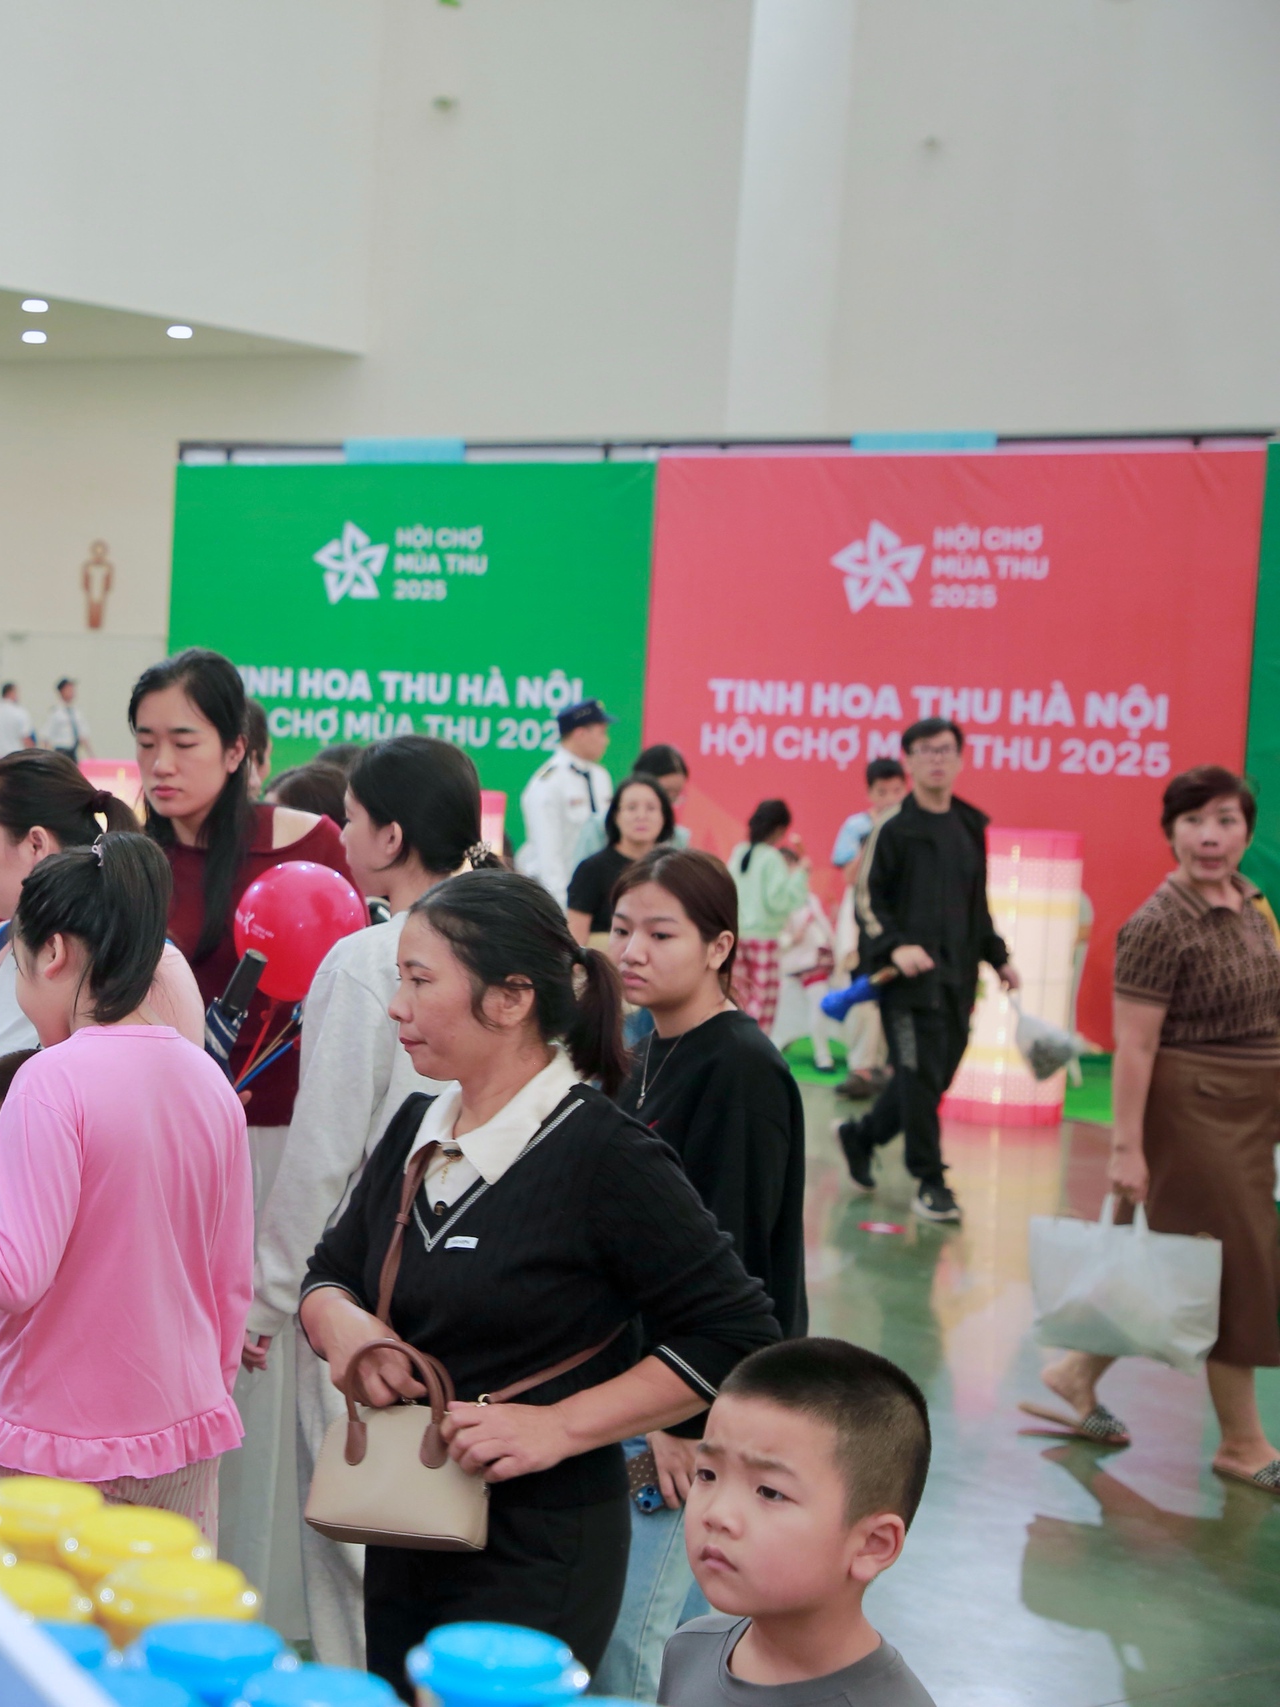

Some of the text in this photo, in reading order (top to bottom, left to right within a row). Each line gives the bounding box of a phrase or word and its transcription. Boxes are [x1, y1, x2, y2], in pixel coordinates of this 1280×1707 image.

[395, 524, 484, 551] HỘI CHỢ
[932, 522, 1044, 553] HỘI CHỢ
[394, 551, 488, 576] MÙA THU
[930, 552, 1050, 581] MÙA THU
[393, 579, 447, 601] 2025
[929, 583, 997, 609] 2025
[297, 668, 373, 701] HOA
[378, 671, 453, 705] THU
[456, 666, 510, 708] HÀ
[515, 669, 584, 716] NỘI
[707, 678, 1170, 740] TINH HOA THU HÀ NỘI
[269, 704, 562, 751] CHỢ MÙA THU 202
[700, 717, 767, 765] HỘI
[772, 725, 860, 771] CHỢ
[967, 733, 1172, 779] THU 2025
